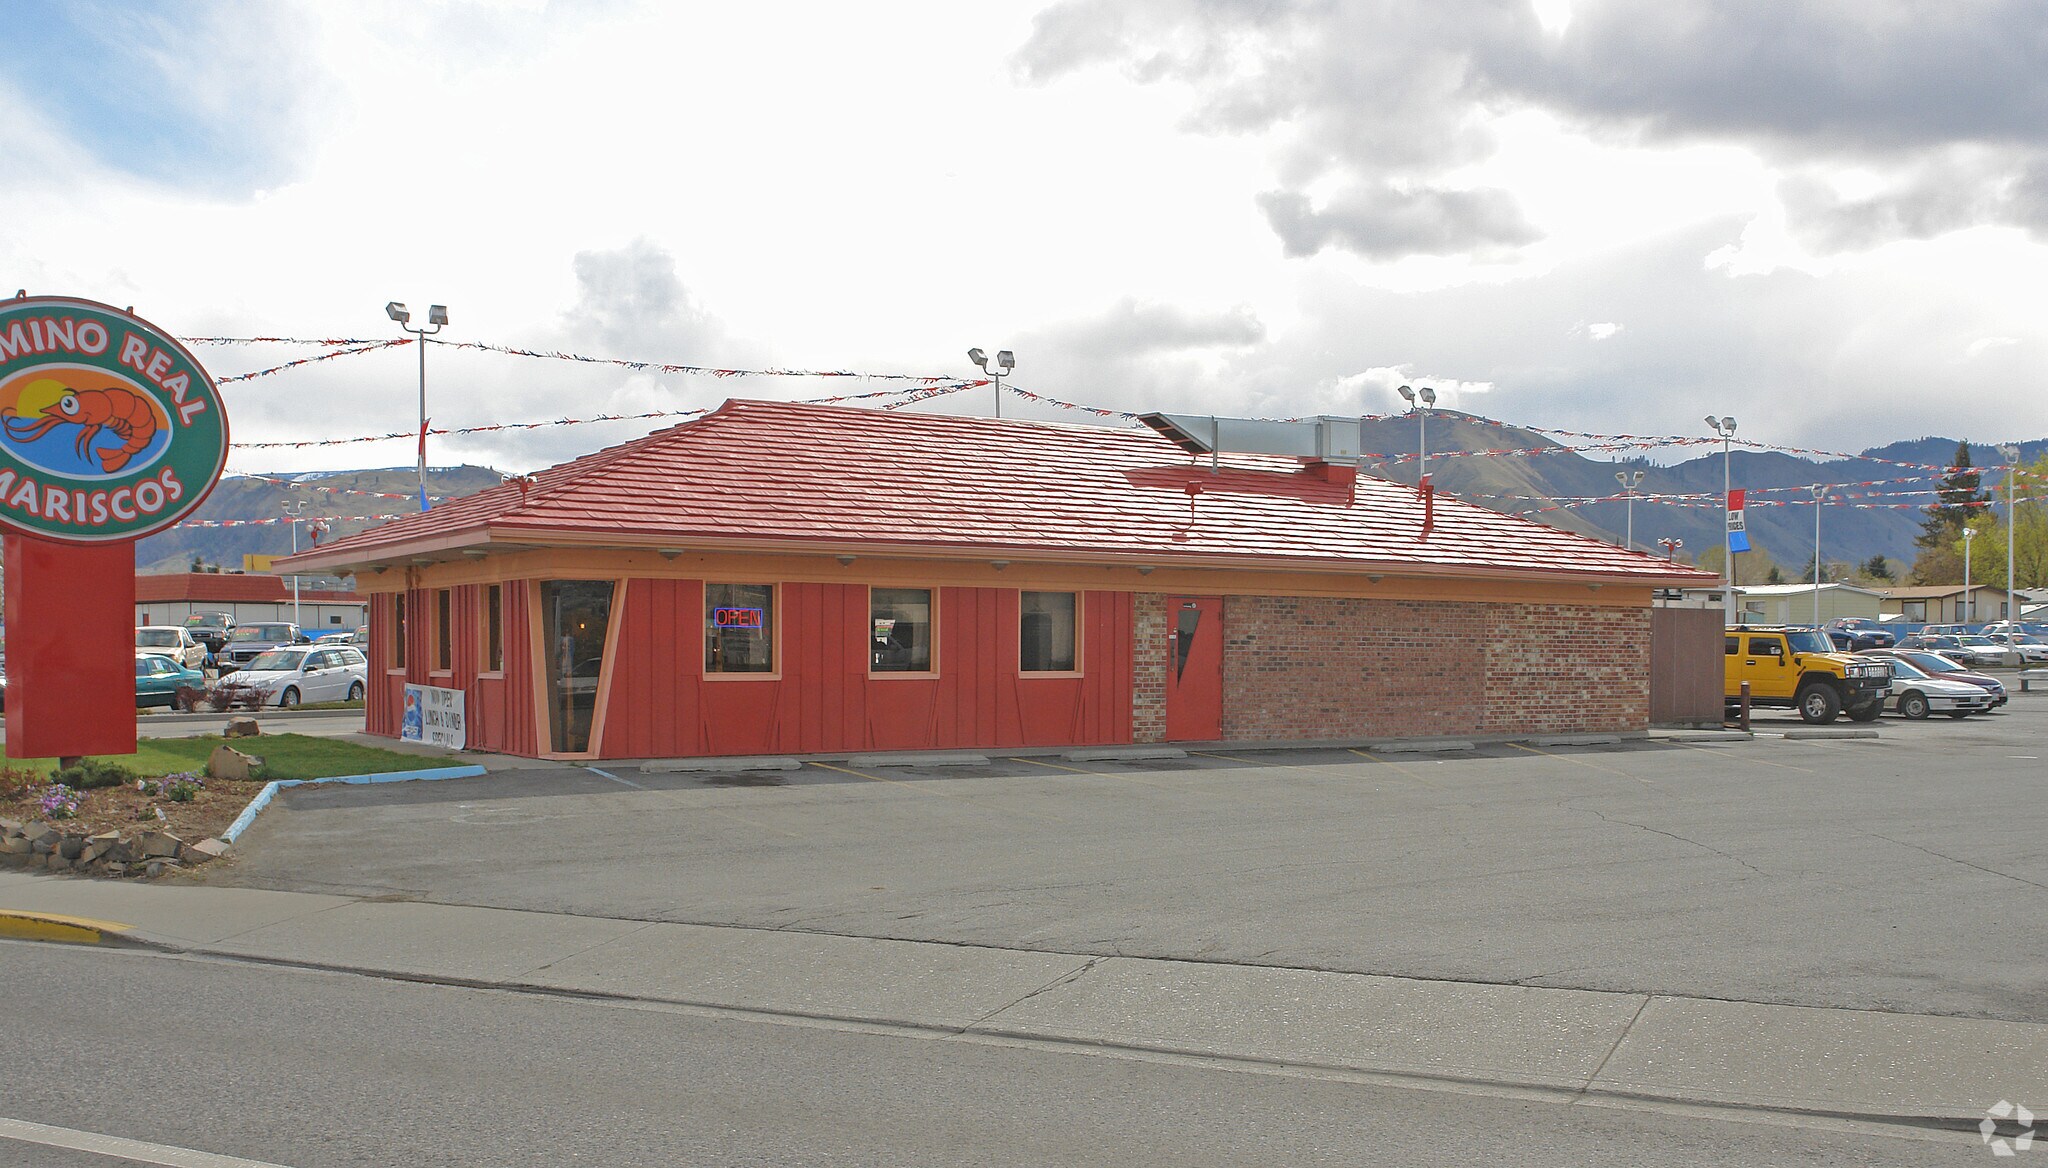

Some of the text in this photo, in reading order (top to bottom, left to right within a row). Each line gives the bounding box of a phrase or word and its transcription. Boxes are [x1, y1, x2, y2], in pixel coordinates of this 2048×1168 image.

[0, 318, 206, 425] MINO REAL
[1728, 511, 1739, 521] LOW
[716, 609, 760, 626] OPEN
[425, 709, 440, 727] LUNCH
[445, 711, 461, 731] DINNER
